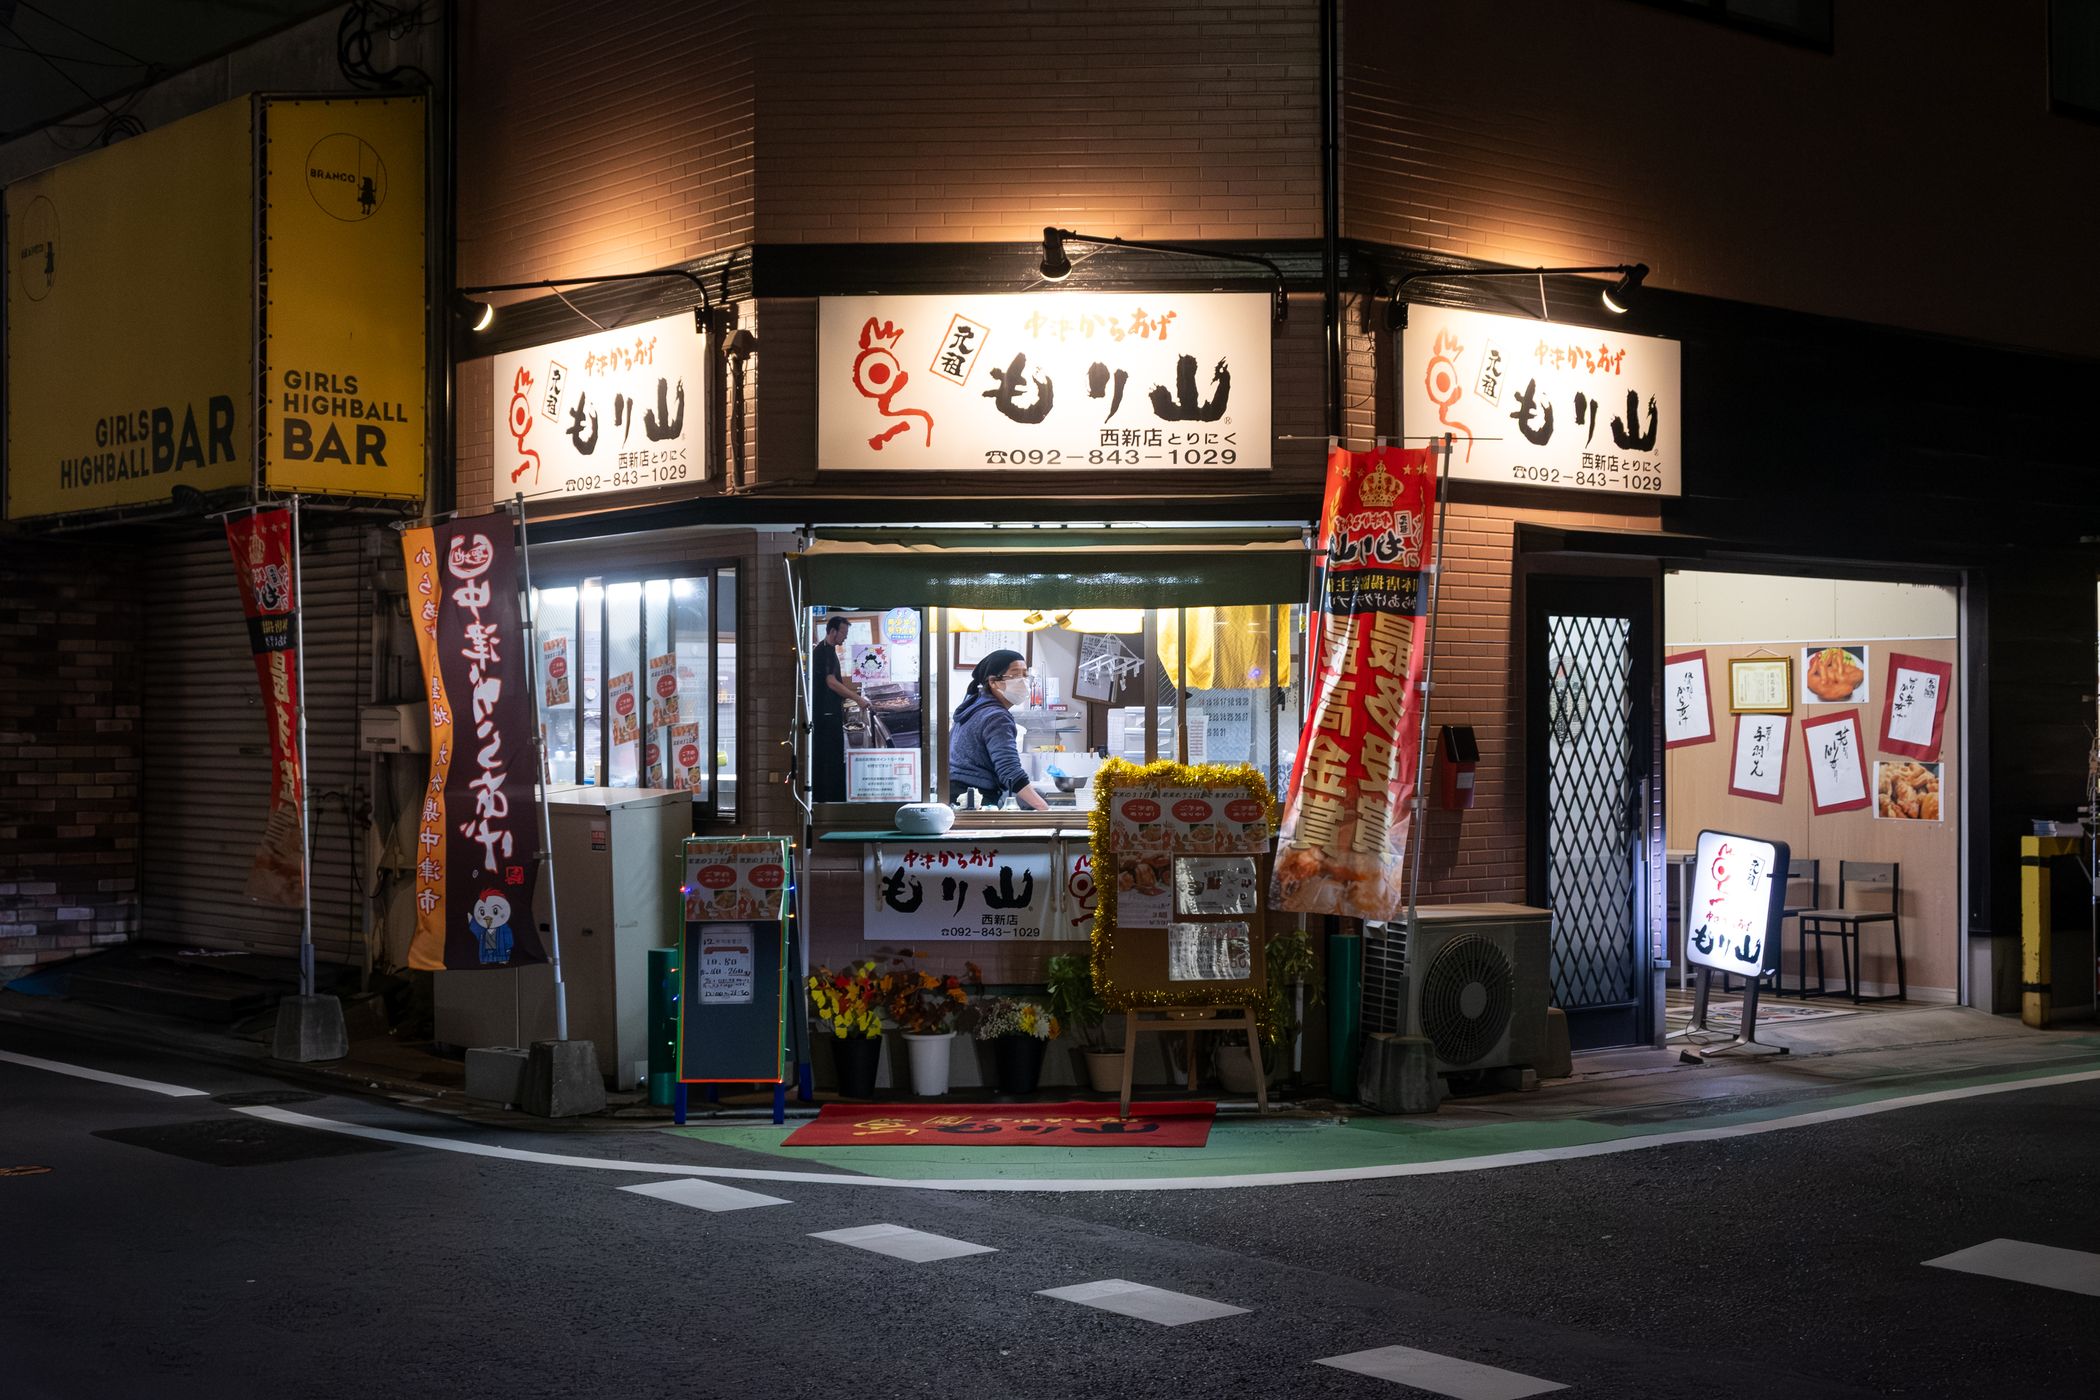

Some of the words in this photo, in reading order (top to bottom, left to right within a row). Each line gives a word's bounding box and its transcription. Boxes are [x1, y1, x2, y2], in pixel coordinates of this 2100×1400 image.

[310, 167, 356, 184] BRANCO
[940, 325, 976, 379] 元祖
[1481, 350, 1502, 399] 元祖
[283, 369, 358, 395] GIRLS
[982, 352, 1232, 425] もり山
[96, 410, 149, 447] GIRLS
[283, 392, 408, 423] HIGHBALL
[566, 374, 685, 456] もり山
[1509, 377, 1658, 453] もり山
[152, 395, 236, 474] BAR
[283, 416, 388, 468] BAR
[60, 446, 149, 490] HIGHBALL
[902, 847, 999, 869] 中津からあげ
[882, 866, 1034, 917] もり山
[981, 914, 1019, 926] 西新店
[1691, 923, 1761, 965] もり山
